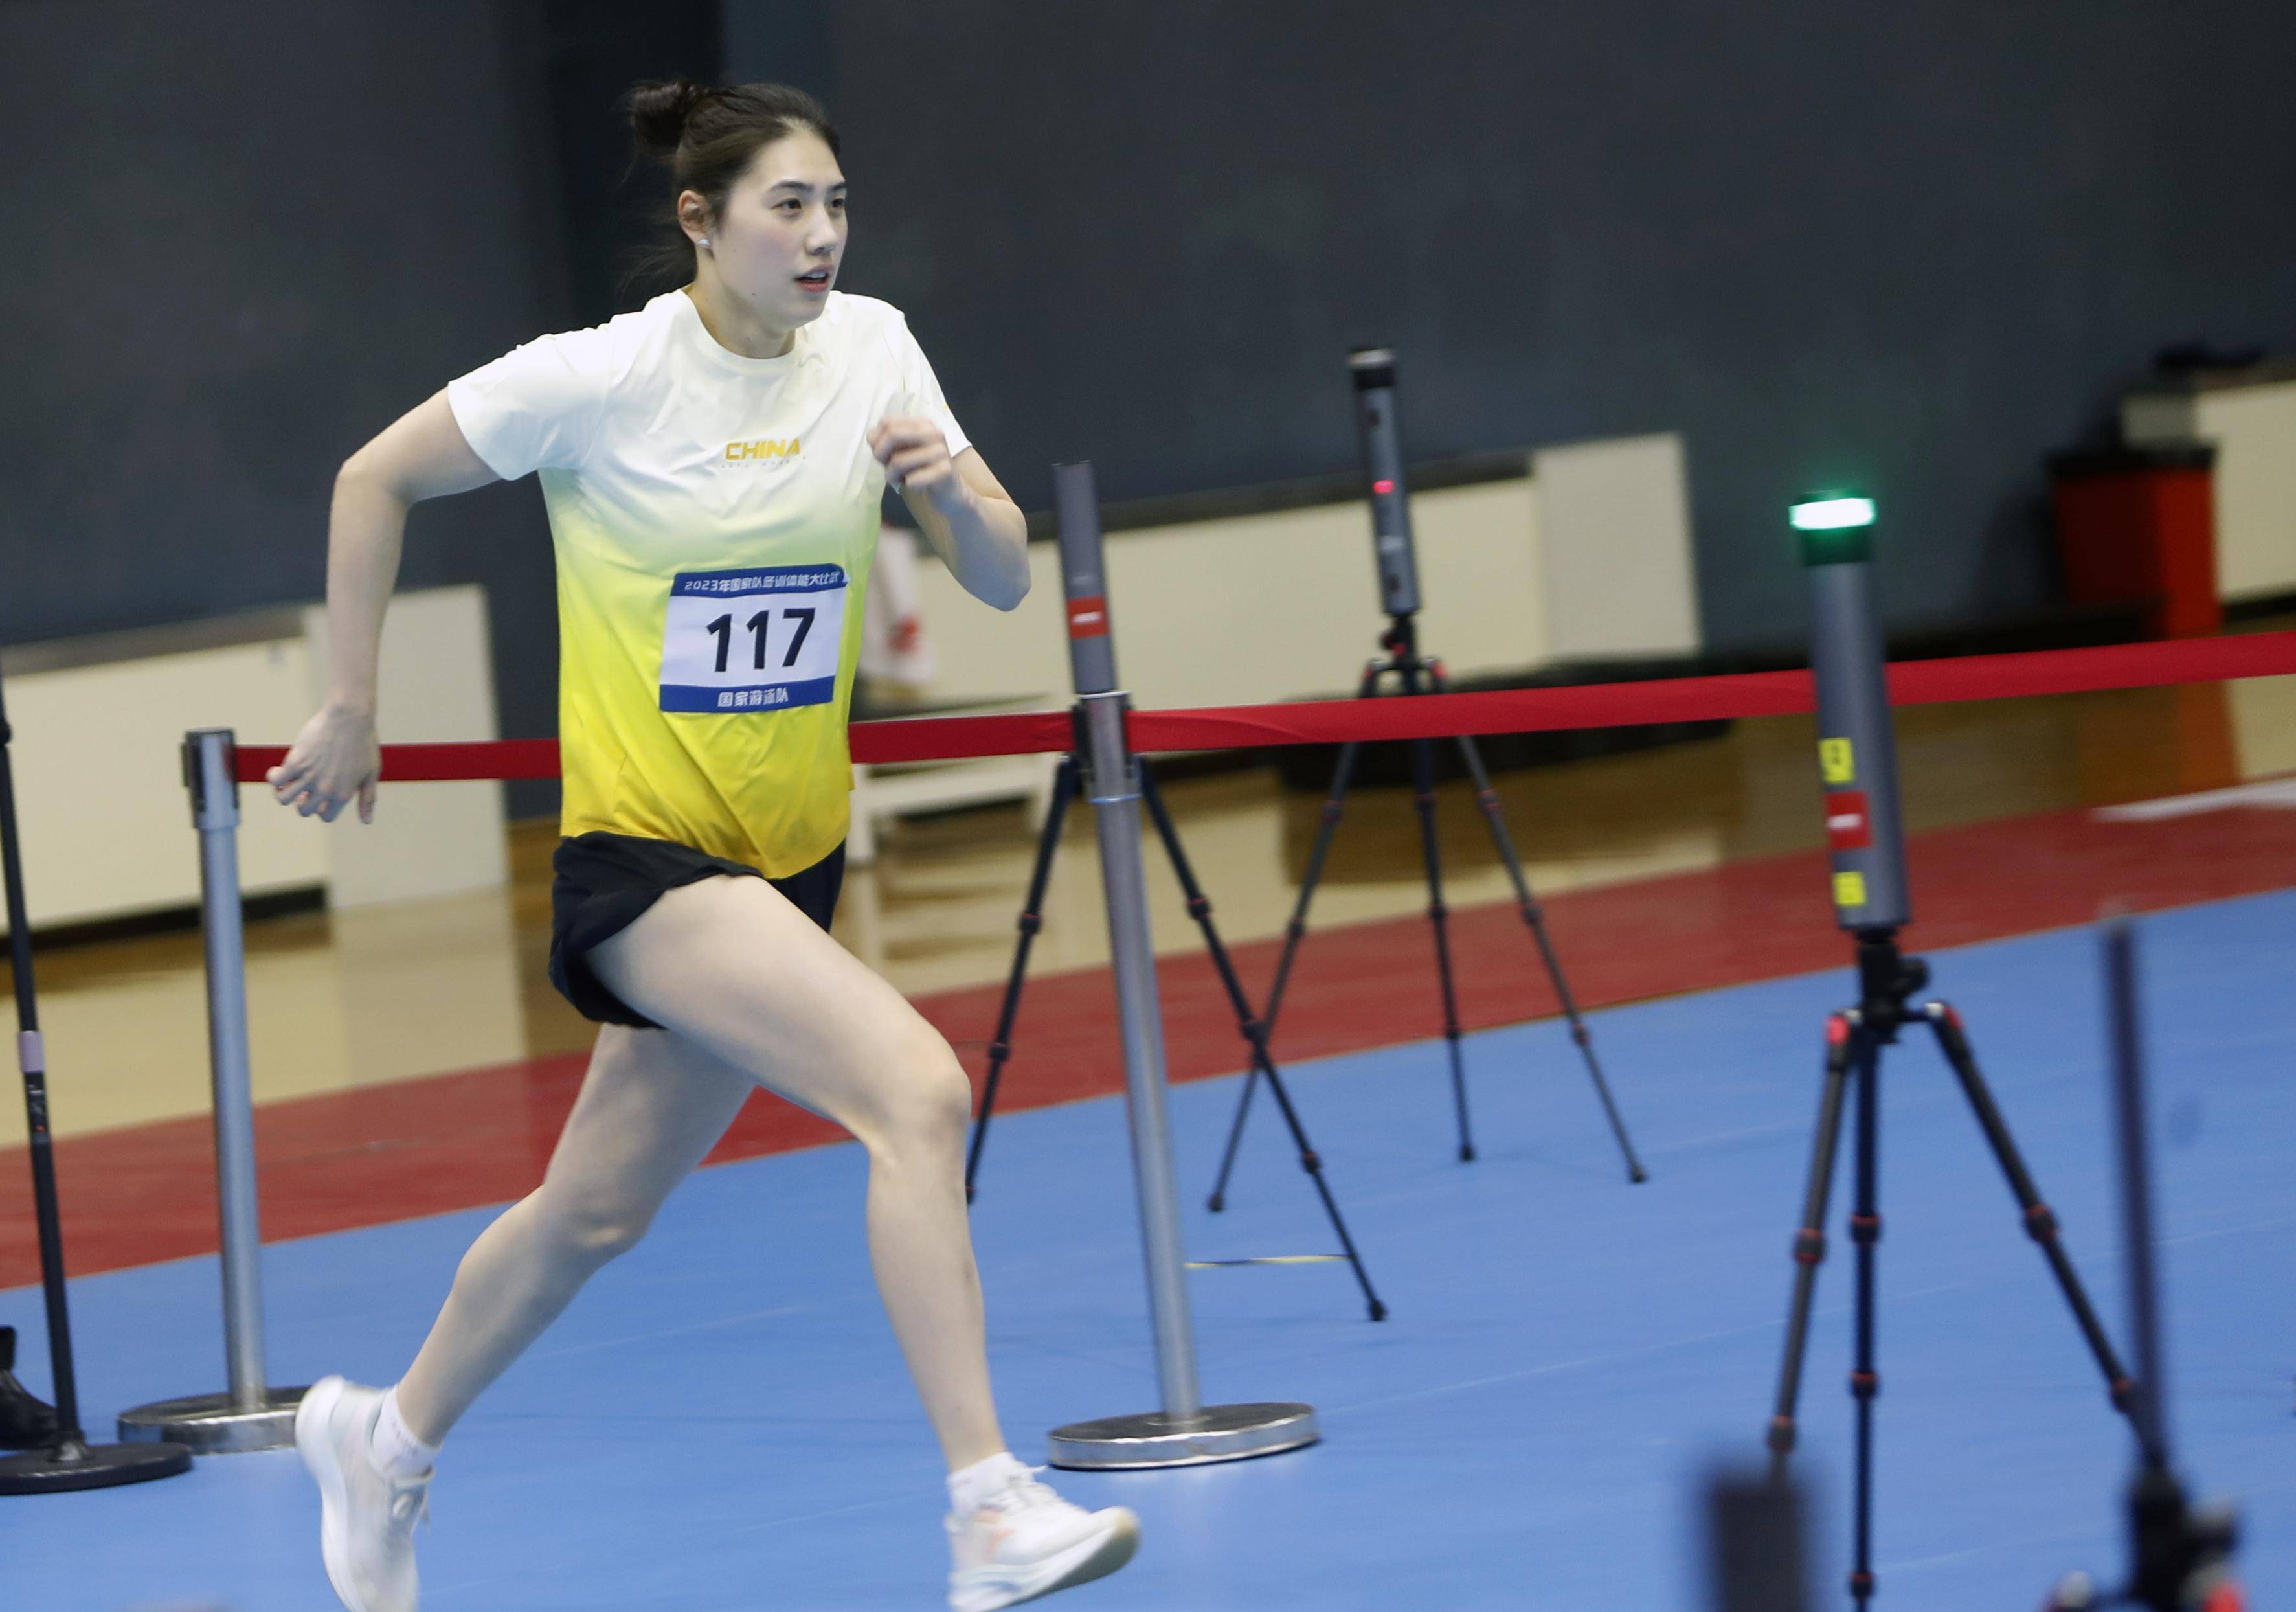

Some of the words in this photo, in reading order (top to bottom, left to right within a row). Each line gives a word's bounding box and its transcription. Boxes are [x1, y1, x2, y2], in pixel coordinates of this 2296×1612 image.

[726, 438, 800, 460] CHINA
[706, 607, 815, 672] 117
[717, 687, 789, 707] 国家游泳队
